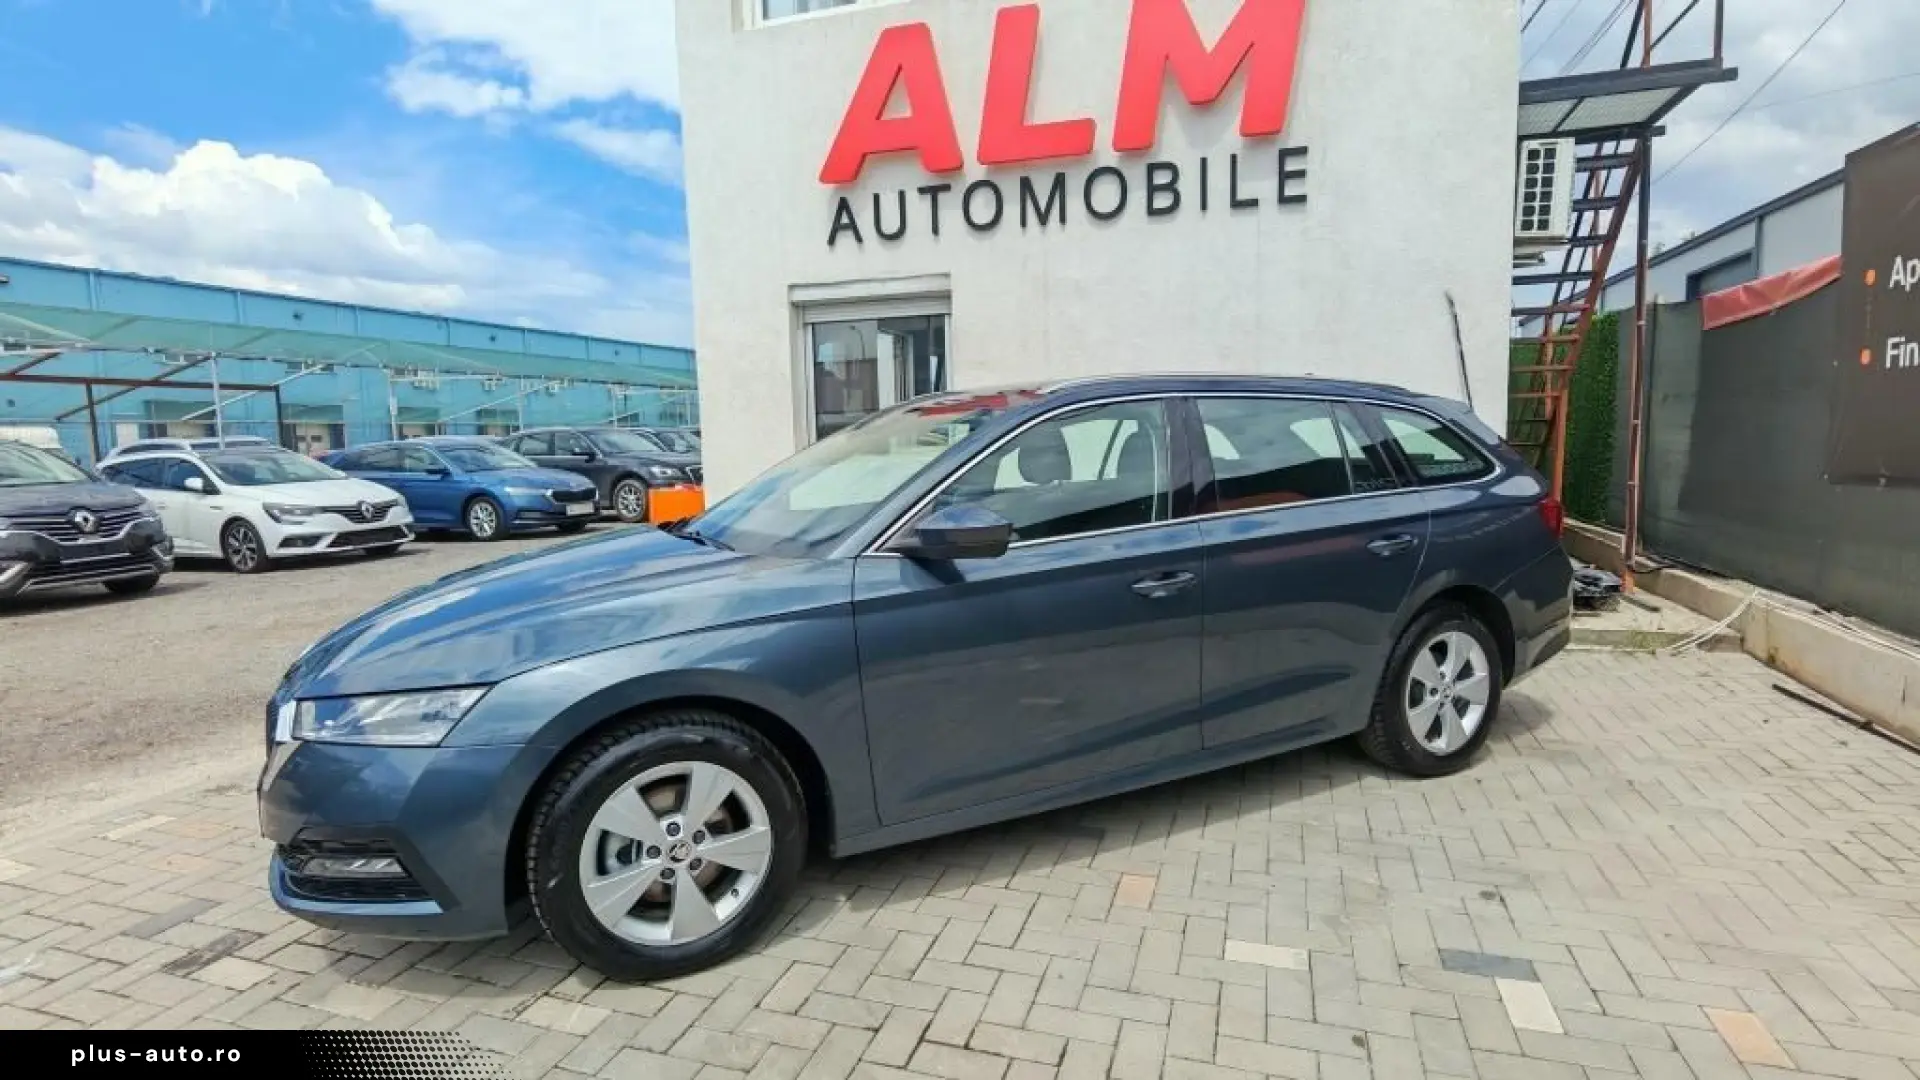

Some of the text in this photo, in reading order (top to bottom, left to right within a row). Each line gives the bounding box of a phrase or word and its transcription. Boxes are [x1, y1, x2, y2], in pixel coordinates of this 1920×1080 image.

[819, 0, 1306, 185] ALM
[827, 146, 1309, 246] AUTOMOBILE
[1885, 336, 1919, 369] Fin
